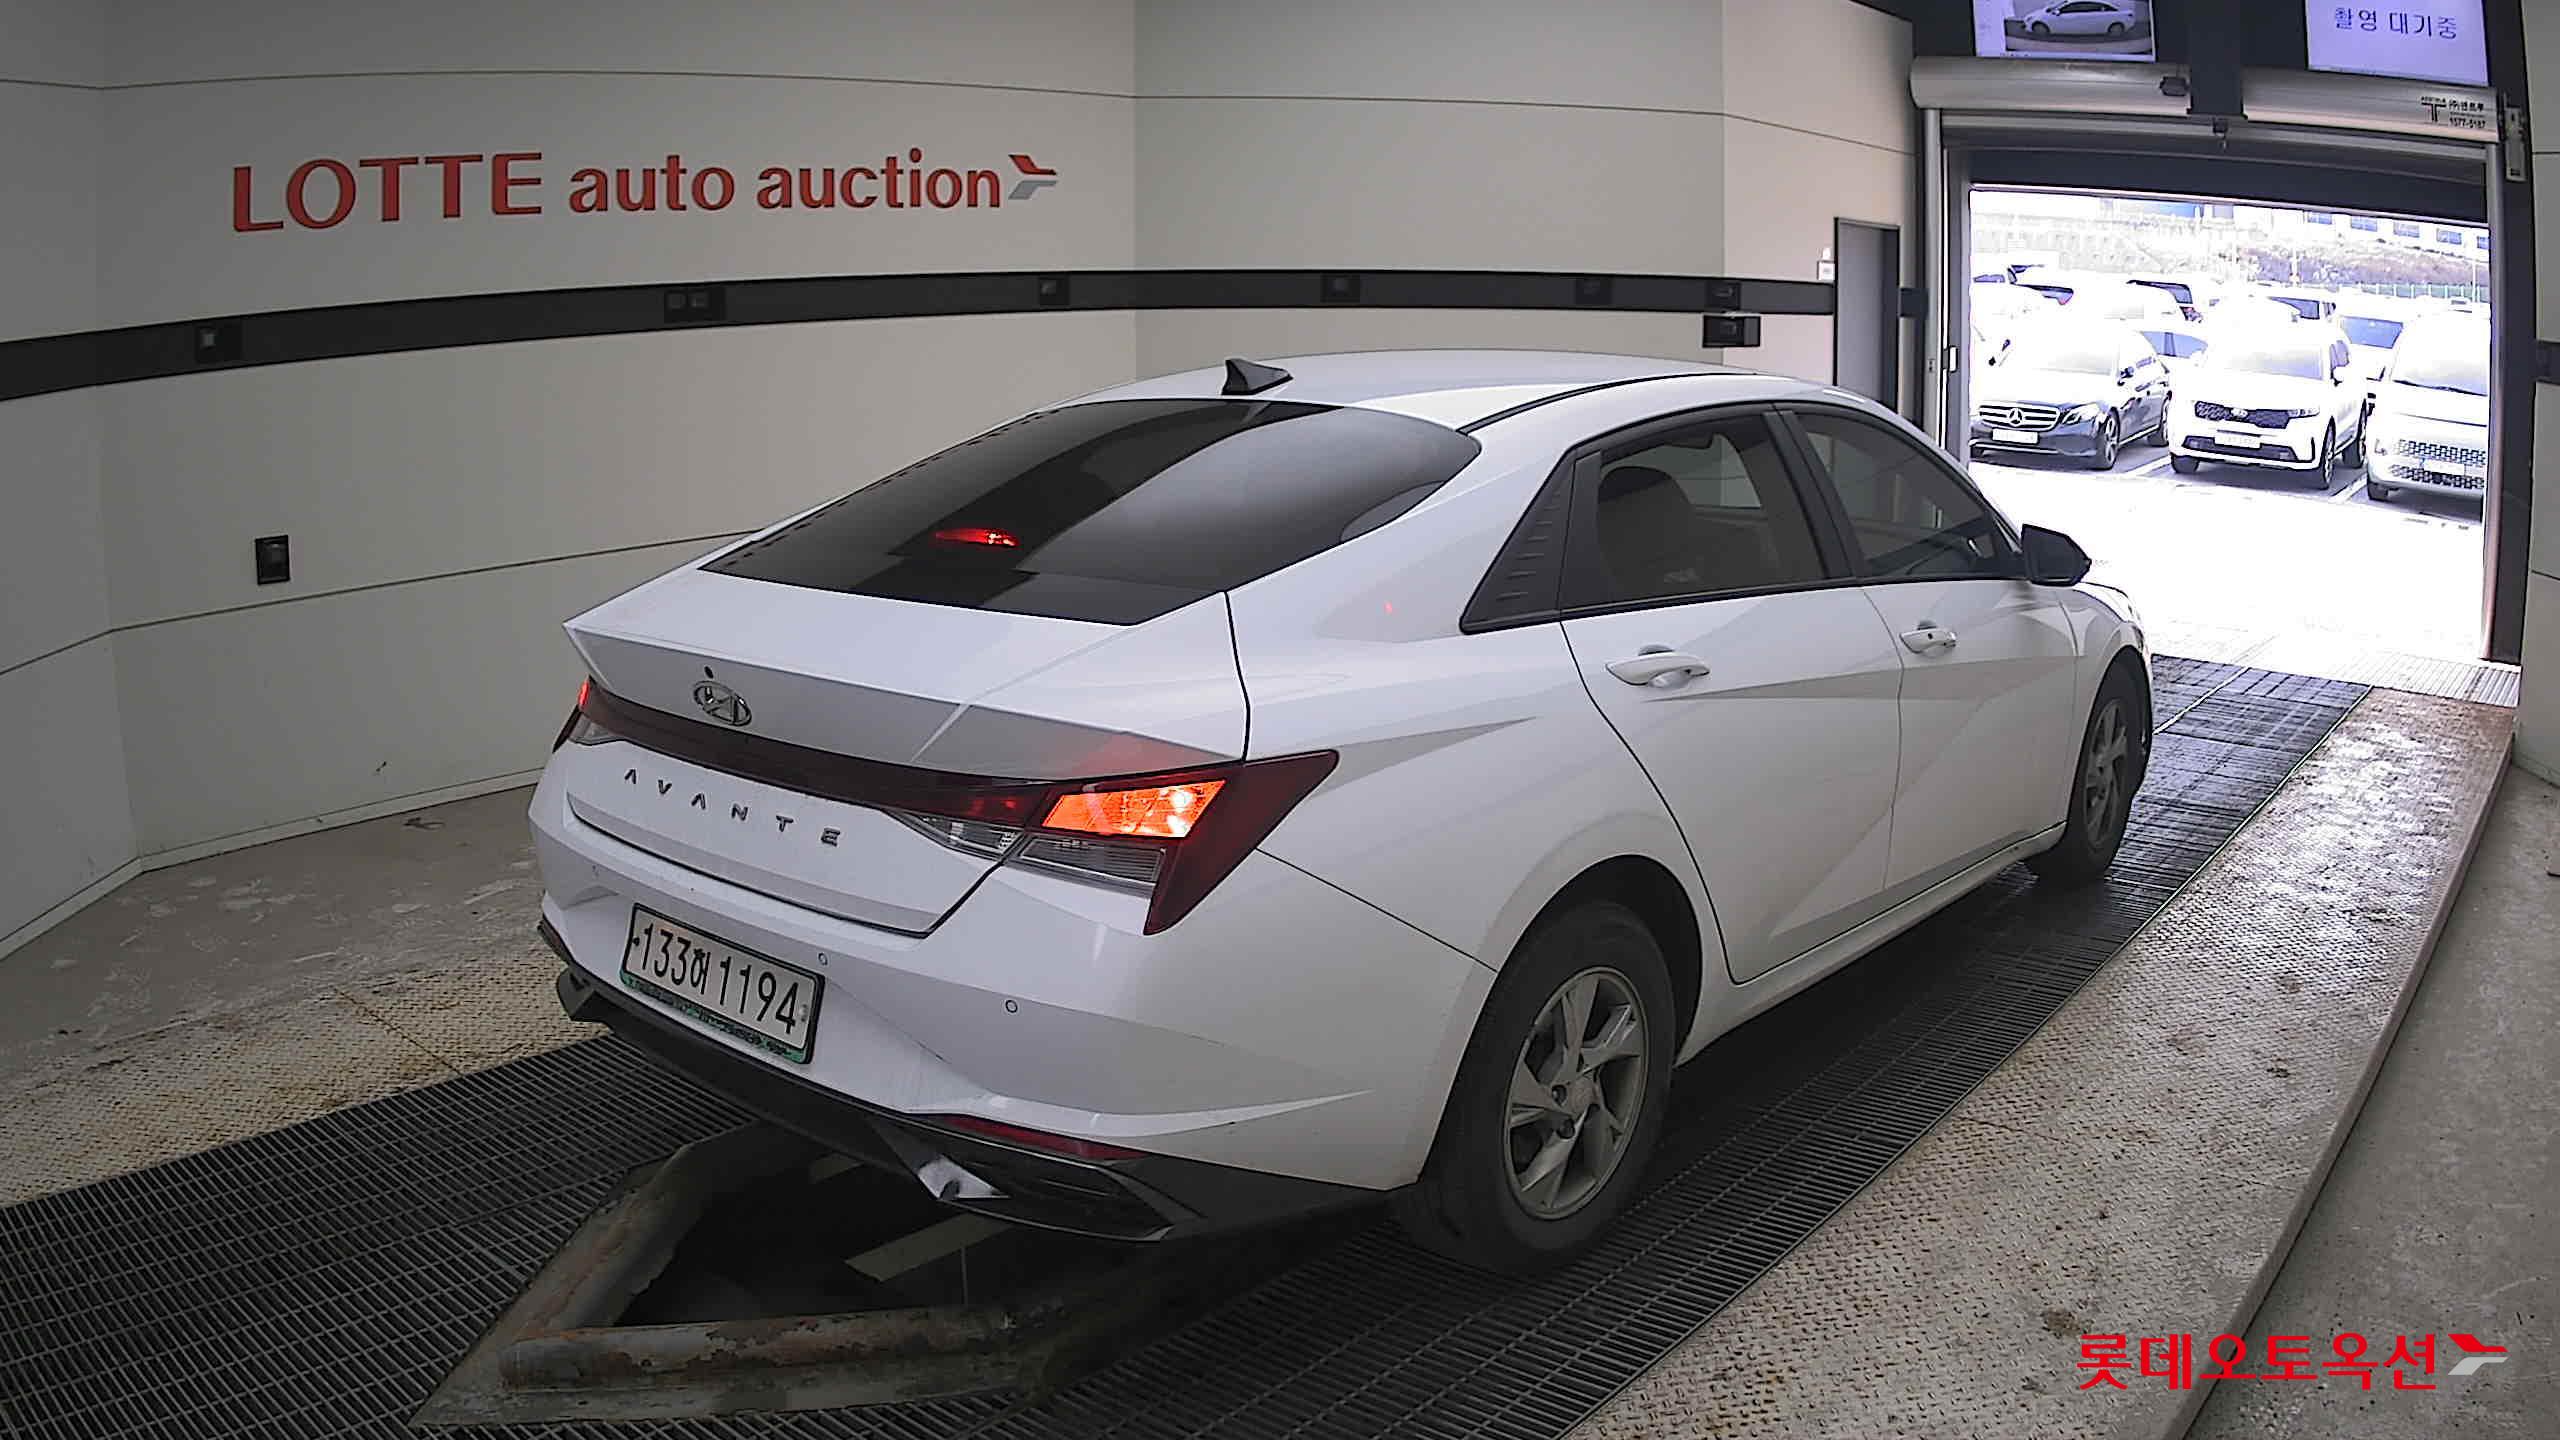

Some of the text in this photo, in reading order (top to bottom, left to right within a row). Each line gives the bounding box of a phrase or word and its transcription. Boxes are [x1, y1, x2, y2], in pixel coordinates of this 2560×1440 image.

[2335, 7, 2457, 39] 촬영 대기중
[234, 149, 1000, 232] LOTTE auto auction
[624, 768, 841, 847] AVANTE
